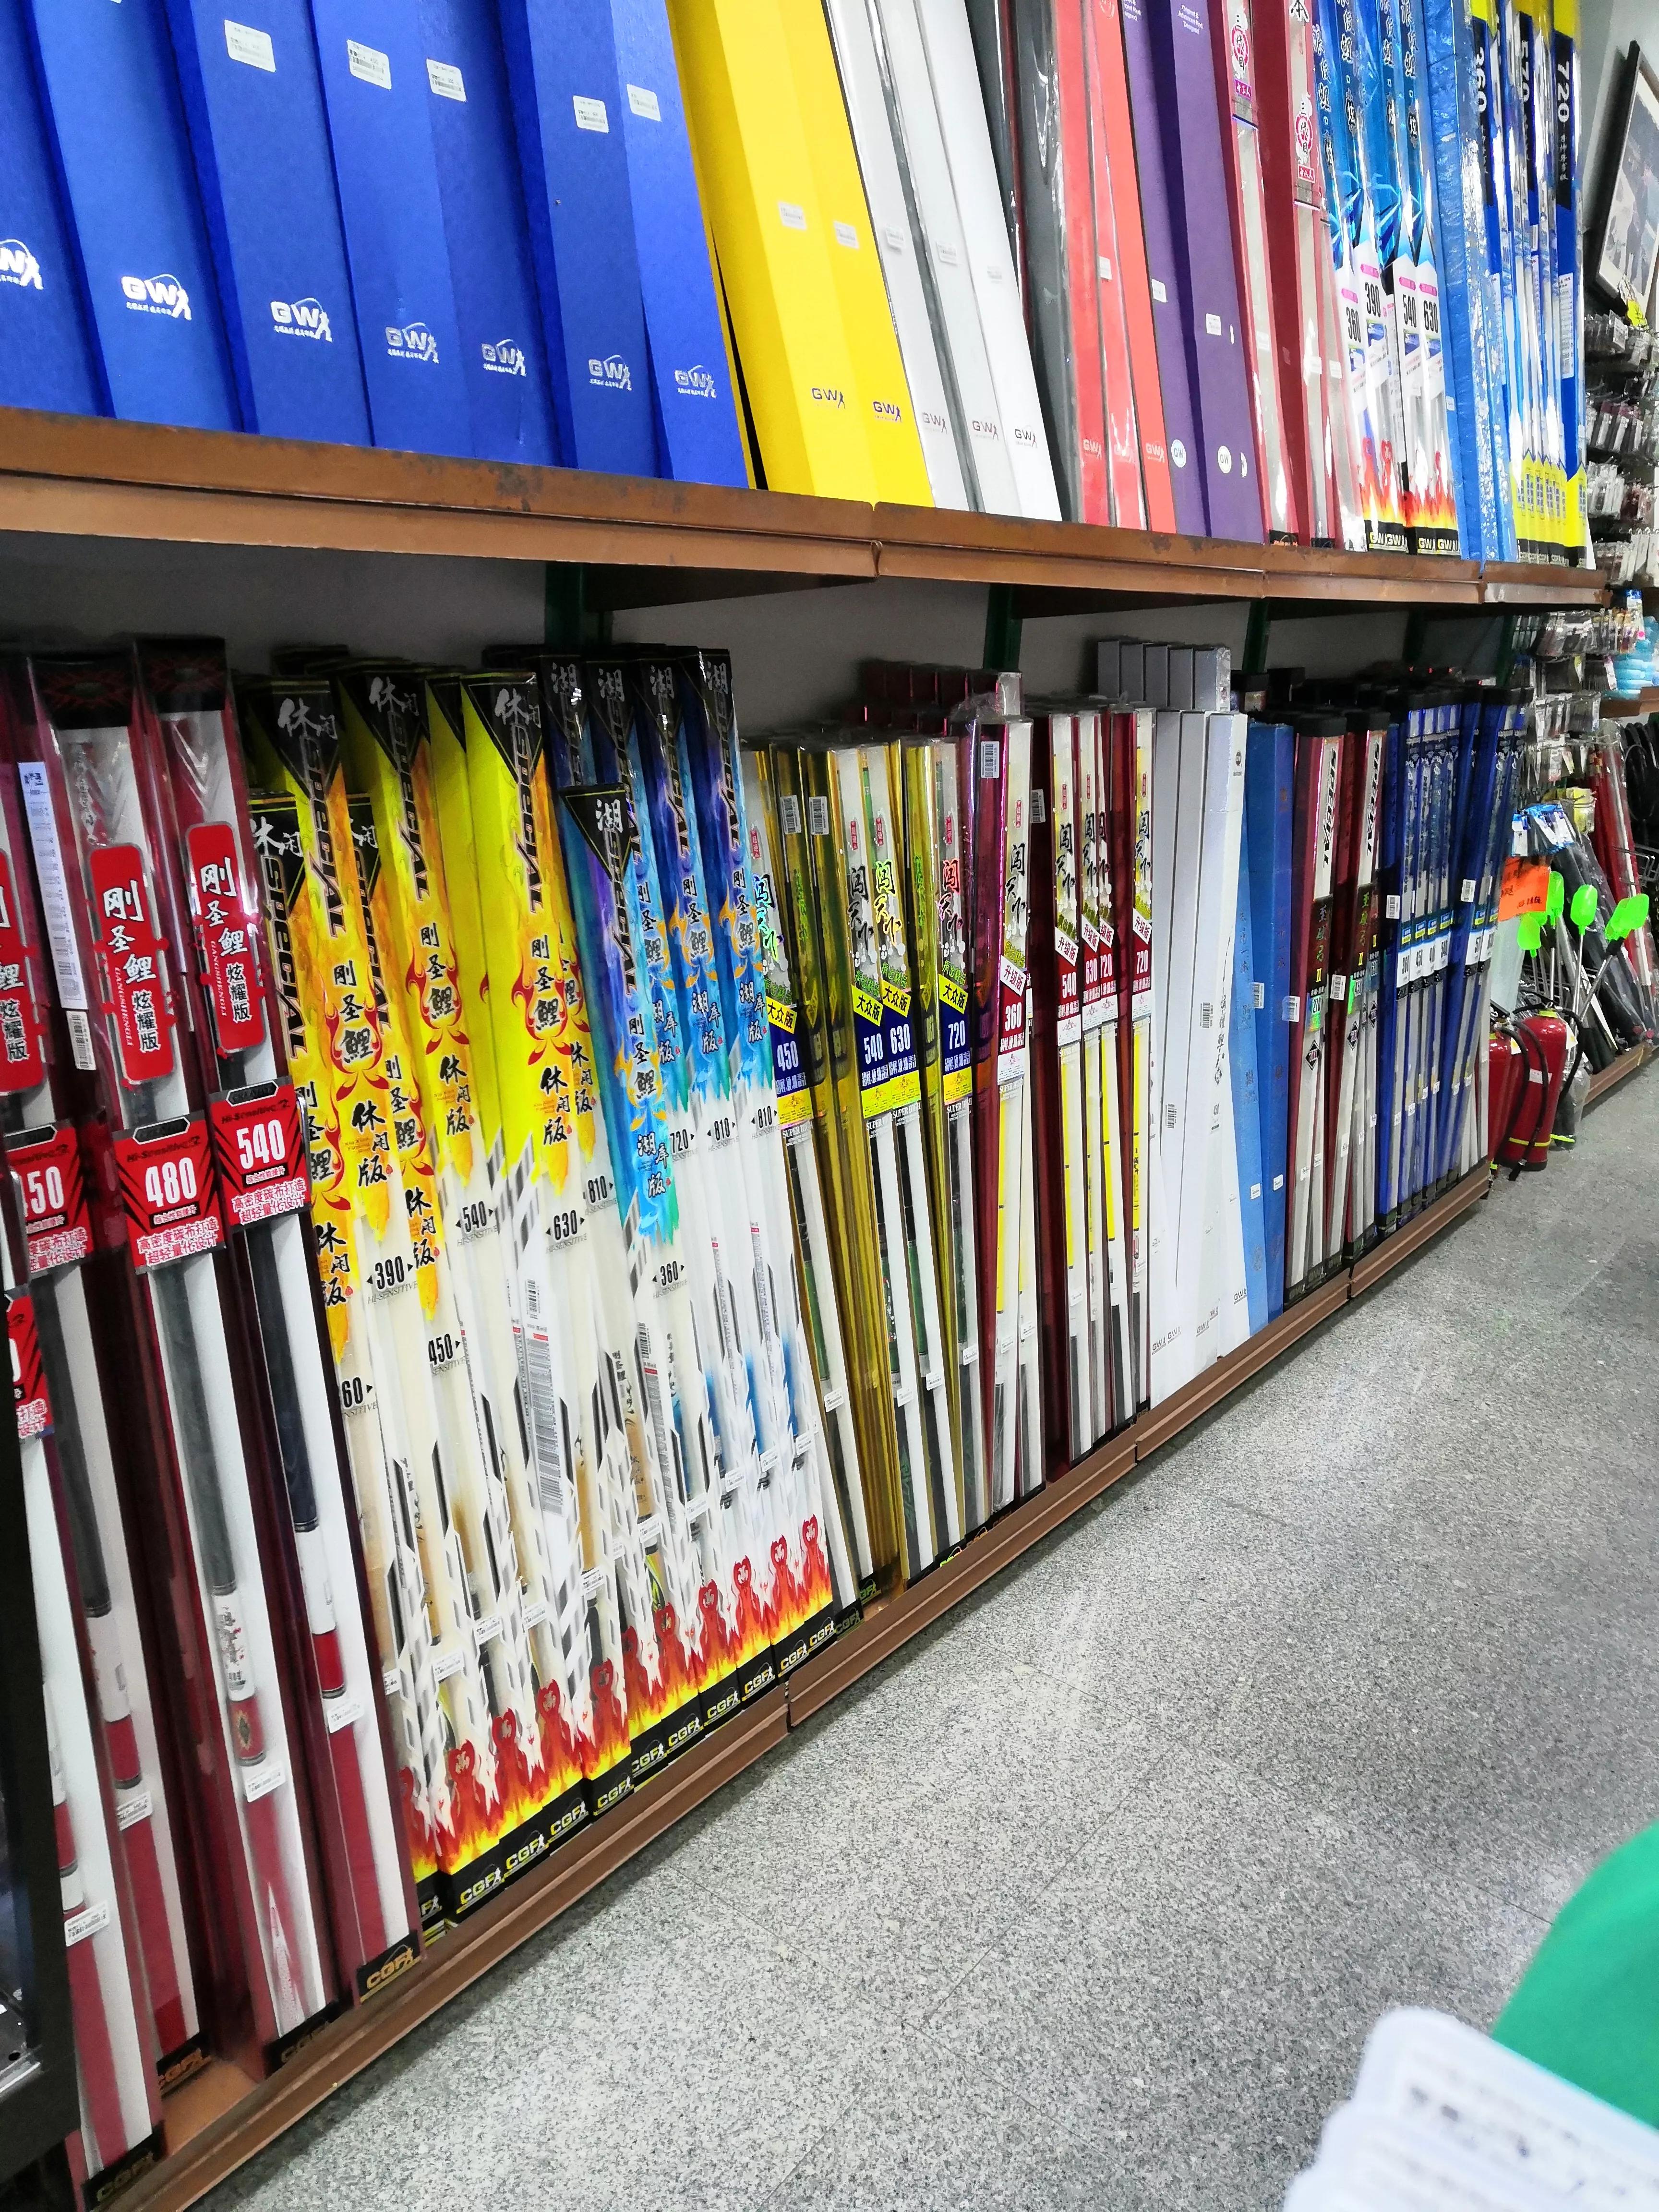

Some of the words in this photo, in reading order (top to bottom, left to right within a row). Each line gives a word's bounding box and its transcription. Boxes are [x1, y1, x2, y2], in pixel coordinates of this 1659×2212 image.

[1476, 47, 1487, 112] 360
[1558, 60, 1570, 123] 720
[1365, 282, 1381, 318] 390
[1403, 294, 1417, 328] 540
[1346, 306, 1361, 343] 360
[1423, 300, 1438, 333] 630
[1083, 923, 1099, 948] 升级版
[1134, 915, 1151, 940] 升级版
[1058, 937, 1077, 962] 升级版
[1136, 950, 1149, 975] 720
[1002, 964, 1025, 993] 升级版
[1061, 971, 1077, 999] 540
[1085, 958, 1098, 985] 630
[226, 962, 252, 1022] 炫耀版
[856, 994, 881, 1022] 大众版
[882, 984, 910, 1012] 大众版
[944, 982, 967, 1010] 大众版
[132, 989, 161, 1053] 炫耀版
[767, 1002, 795, 1029] 大众版
[1005, 1002, 1022, 1032] 360
[864, 1033, 882, 1065] 540
[890, 1023, 911, 1055] 630
[948, 1020, 966, 1050] 720
[777, 1040, 799, 1071] 450
[440, 1054, 471, 1136] 休闲版
[540, 1066, 570, 1146] 休闲版
[713, 1116, 731, 1141] 810
[757, 1105, 772, 1129] 810
[236, 1119, 286, 1170] 540
[351, 1100, 389, 1188] 休闲版
[670, 1129, 690, 1156] 720
[25, 1166, 65, 1217] 50
[145, 1157, 197, 1208] 480
[587, 1176, 607, 1203] 810
[461, 1200, 488, 1236] 540
[552, 1209, 578, 1241] 630
[374, 1255, 406, 1291] 390
[660, 1260, 679, 1286] 360
[428, 1333, 454, 1366] 450
[341, 1376, 363, 1409] 60
